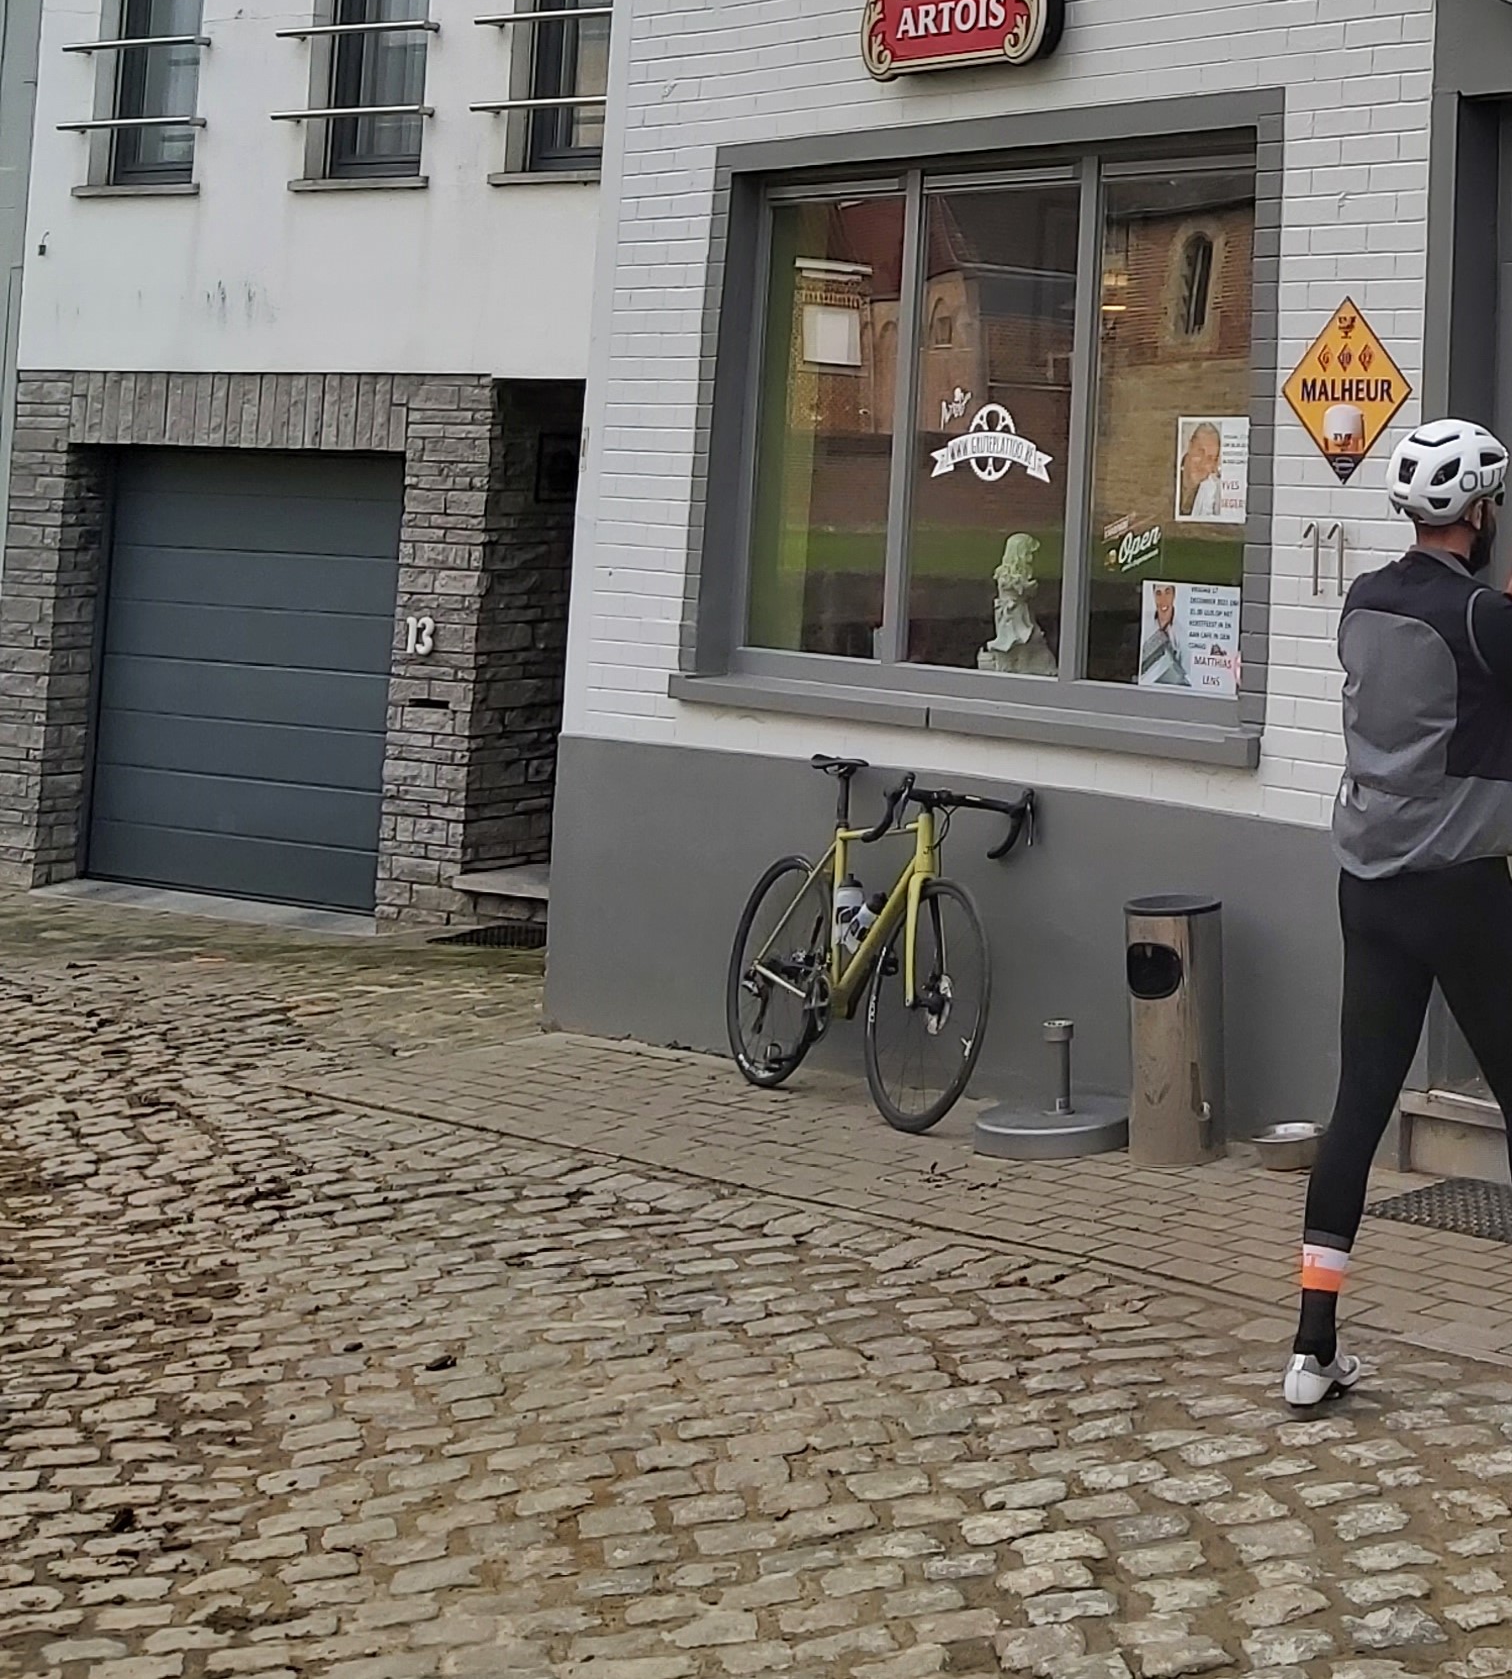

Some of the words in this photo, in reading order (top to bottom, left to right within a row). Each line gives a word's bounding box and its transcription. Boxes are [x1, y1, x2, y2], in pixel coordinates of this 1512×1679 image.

[1301, 377, 1396, 404] MALHEUR
[1118, 525, 1161, 564] Open
[407, 616, 435, 655] 13
